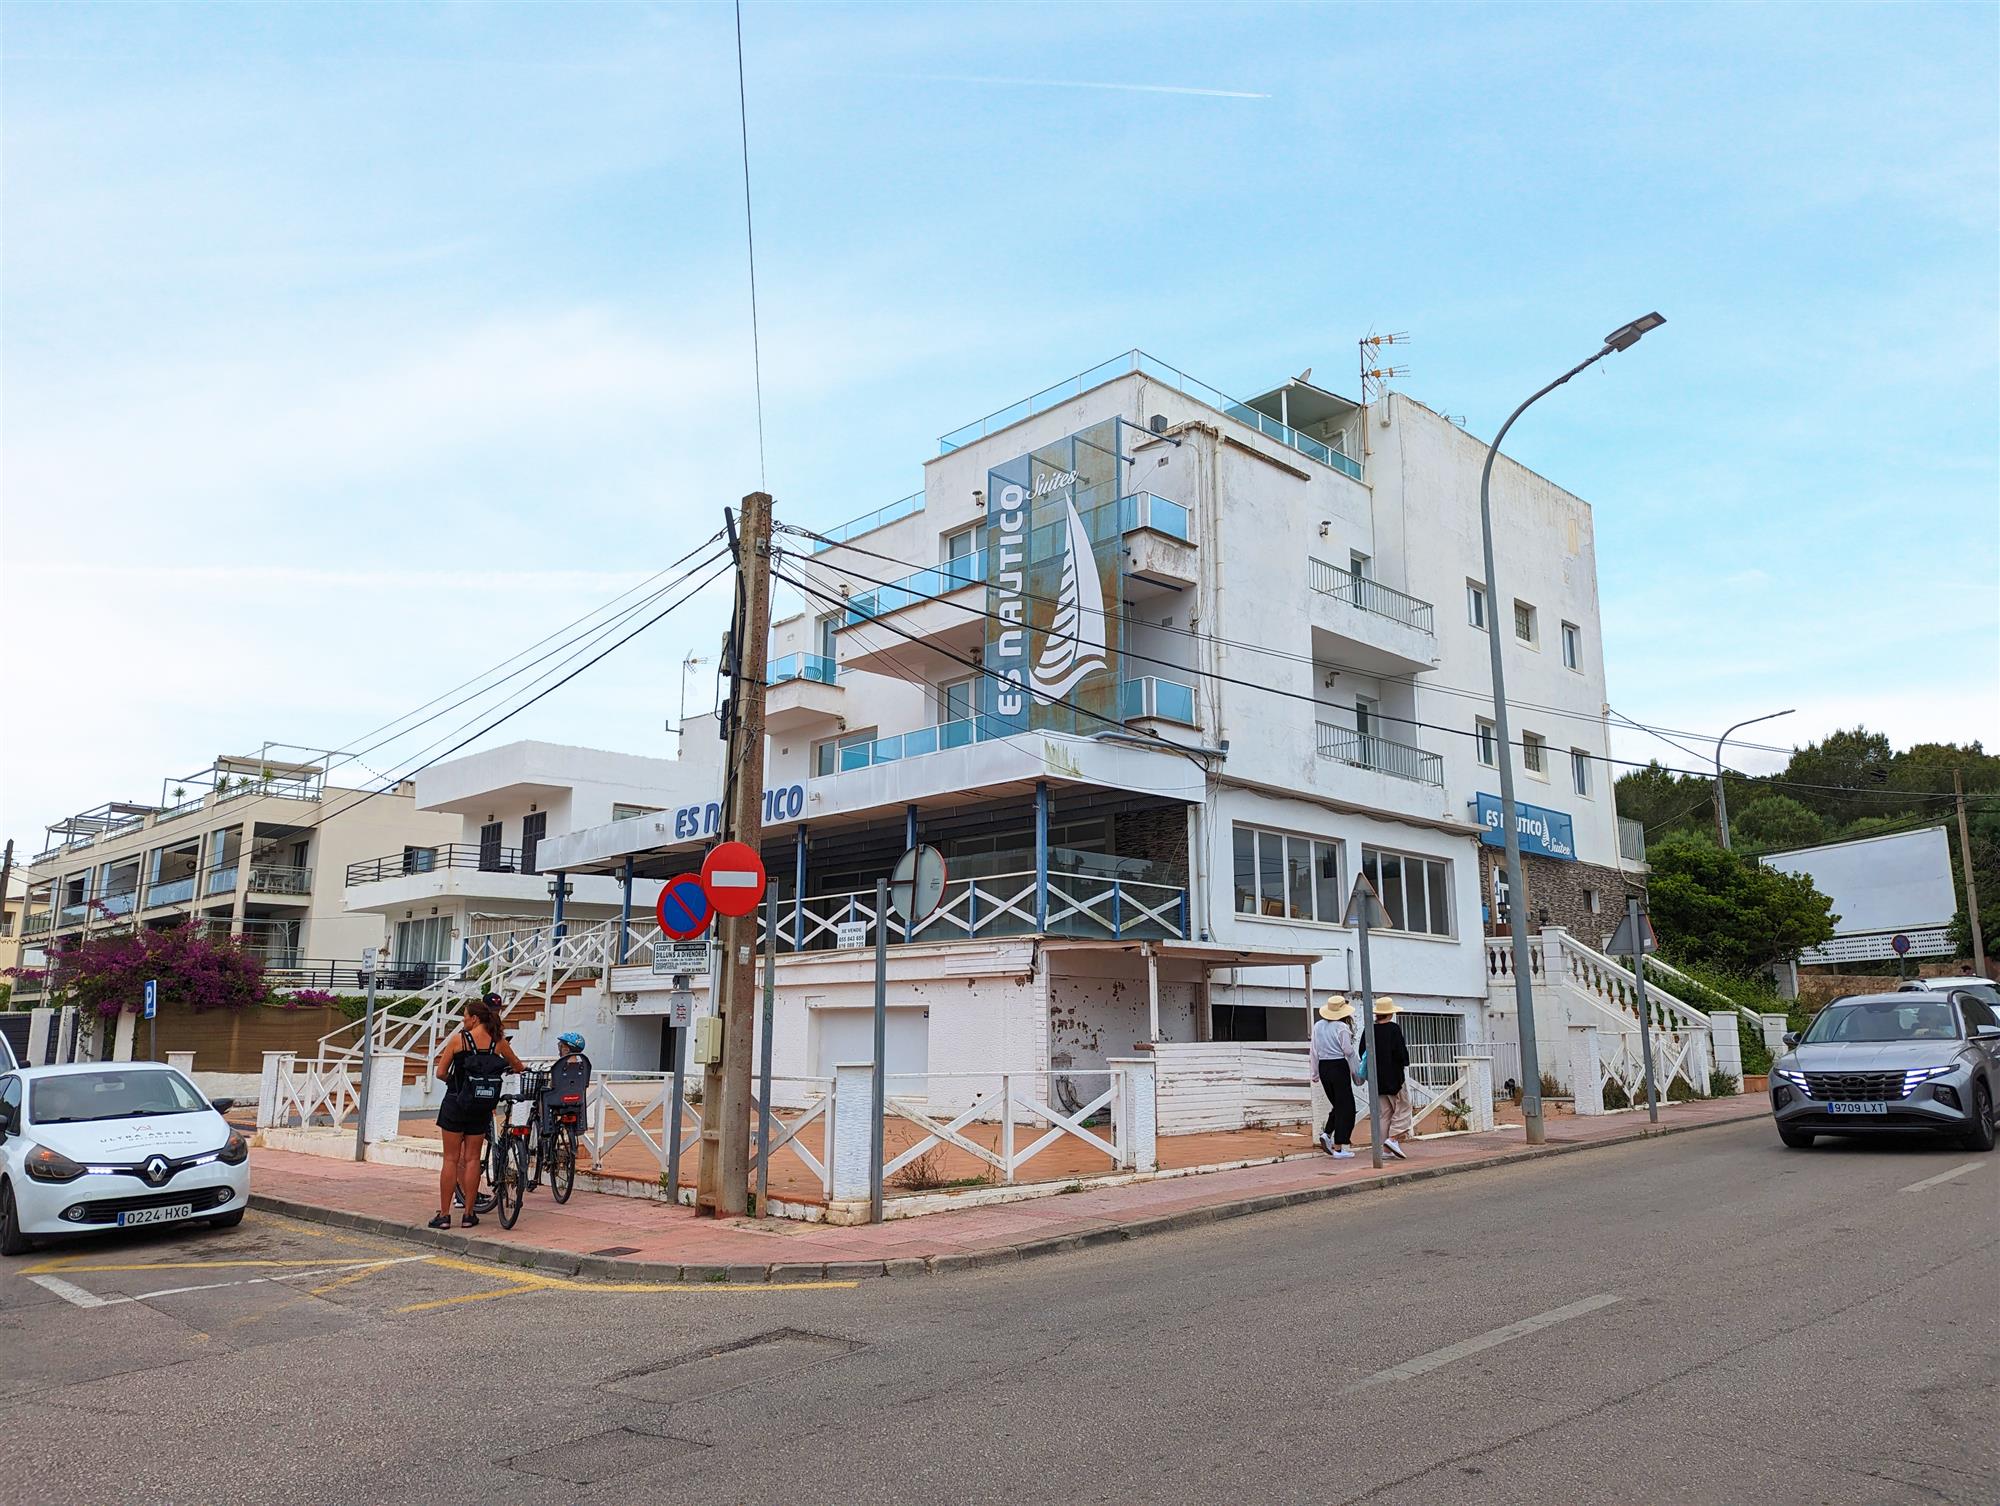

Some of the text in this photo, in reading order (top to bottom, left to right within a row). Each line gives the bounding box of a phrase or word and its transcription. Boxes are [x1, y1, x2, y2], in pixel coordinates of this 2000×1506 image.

[1026, 469, 1079, 500] Suites
[997, 484, 1024, 716] ES NAUTICO
[674, 785, 804, 839] ES NICO
[1485, 809, 1542, 836] ES UTICO
[1547, 837, 1572, 856] Suites
[1834, 1103, 1884, 1113] 9709 LXT
[127, 1206, 189, 1225] 0224 HXG
